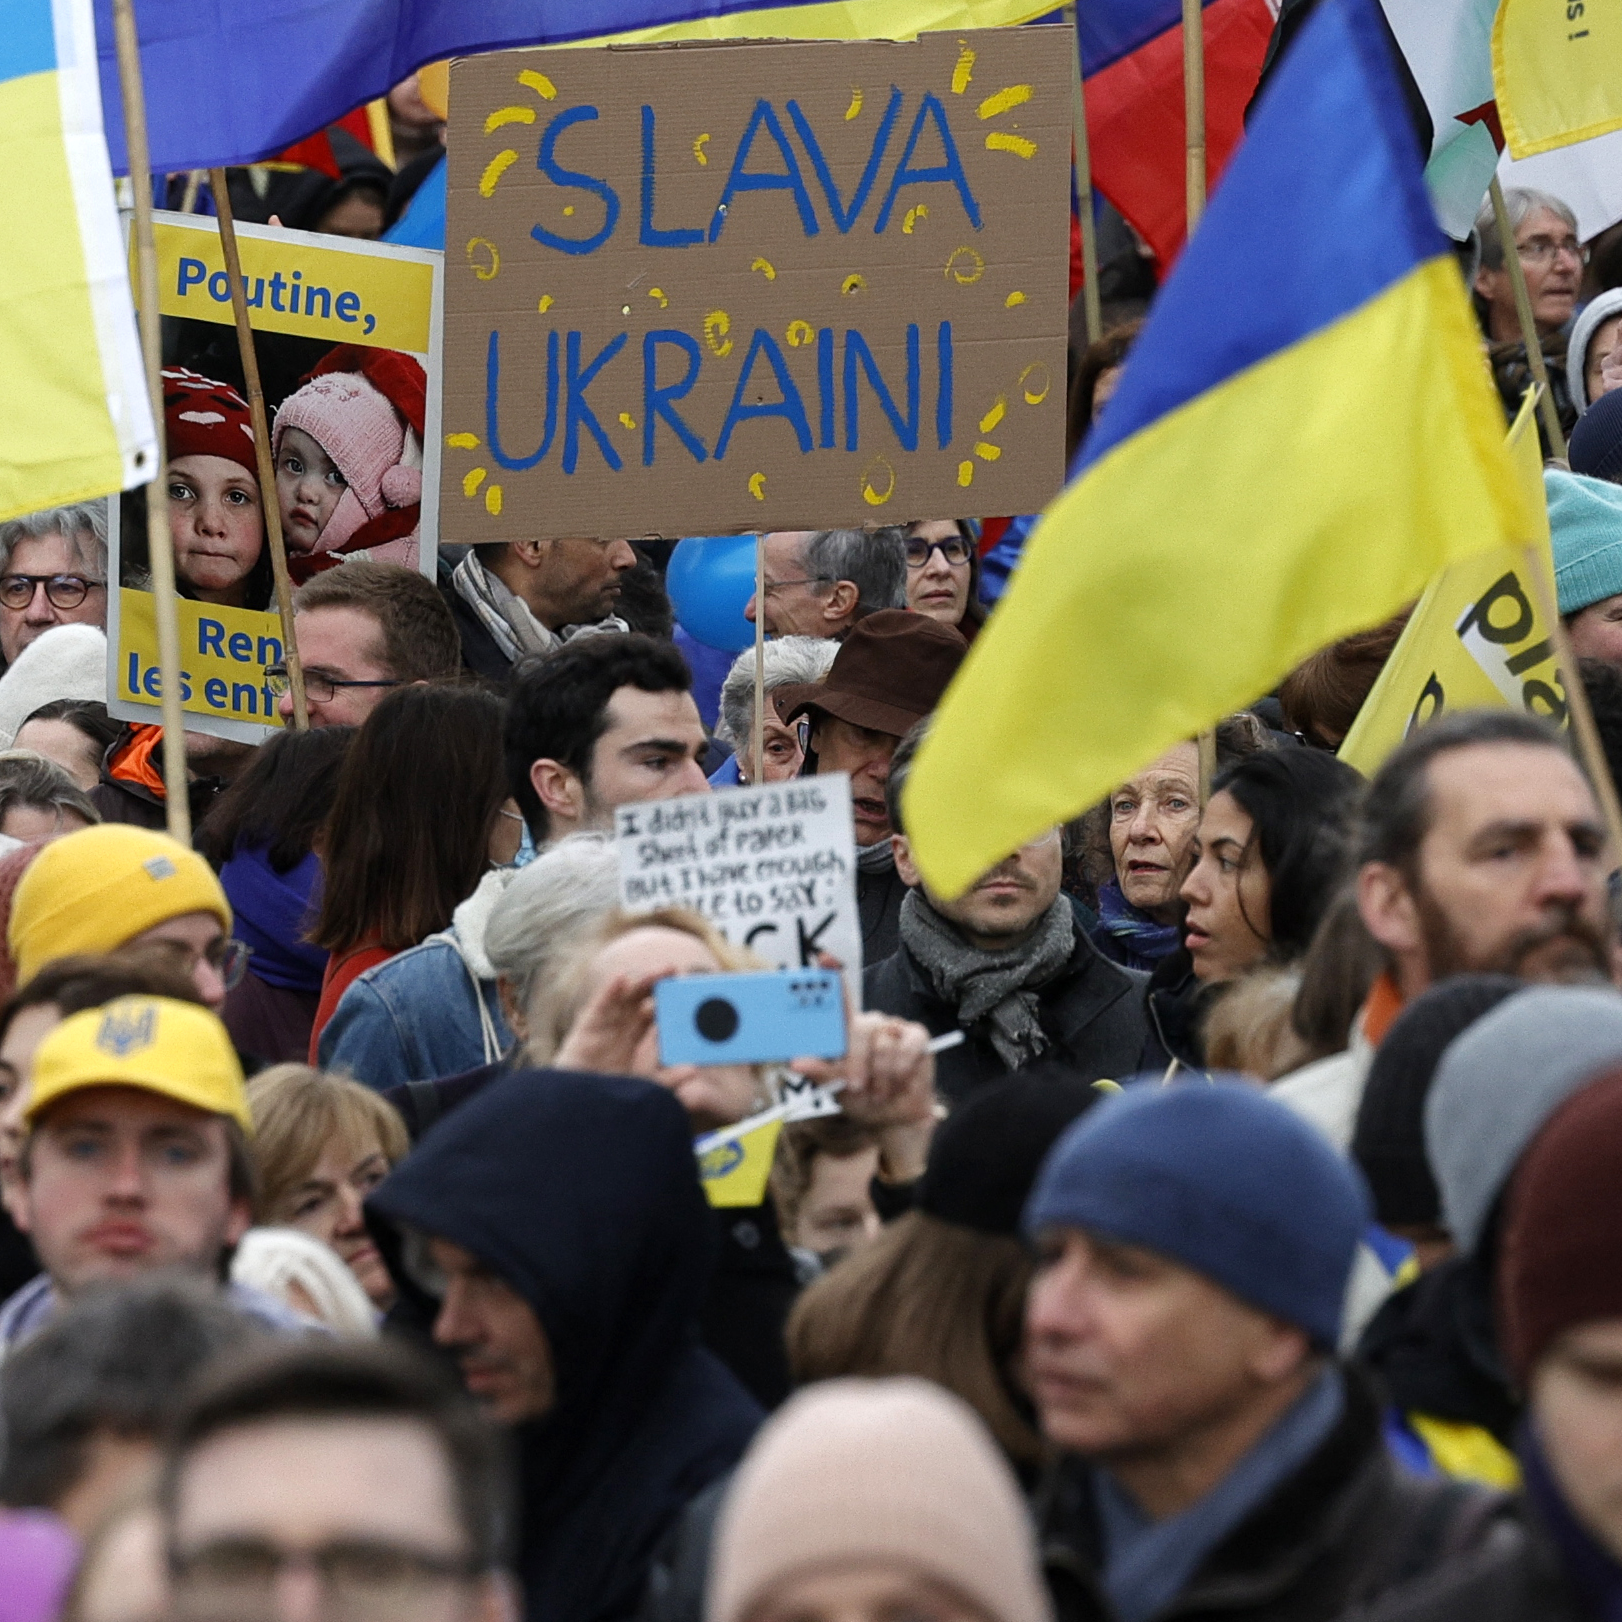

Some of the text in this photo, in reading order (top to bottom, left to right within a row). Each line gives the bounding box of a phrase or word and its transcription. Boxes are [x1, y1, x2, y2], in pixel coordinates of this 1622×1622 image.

[530, 84, 984, 255] SLAVA
[176, 256, 379, 336] Poutine,
[485, 320, 953, 474] UKRAINI
[127, 651, 193, 703] les
